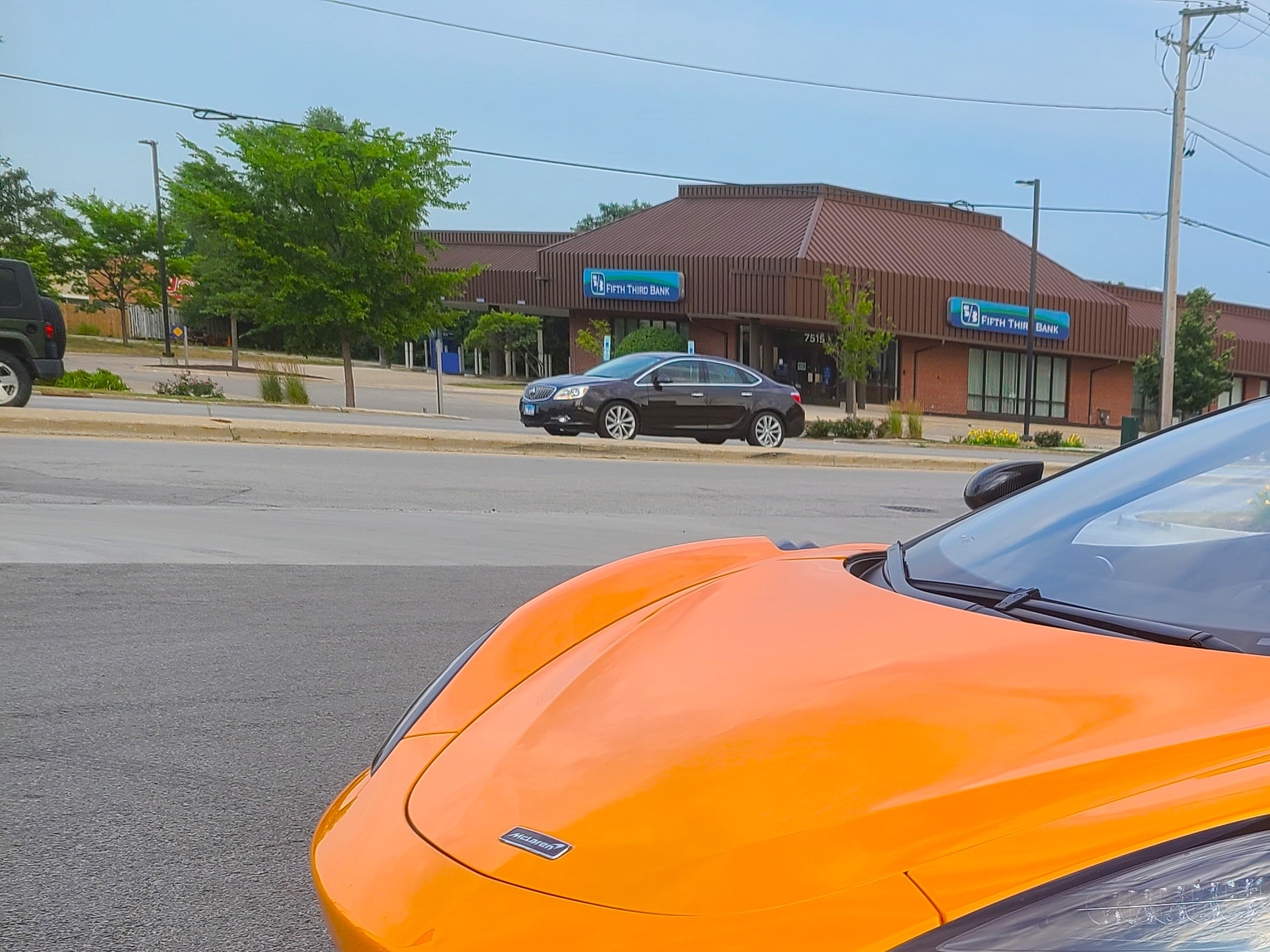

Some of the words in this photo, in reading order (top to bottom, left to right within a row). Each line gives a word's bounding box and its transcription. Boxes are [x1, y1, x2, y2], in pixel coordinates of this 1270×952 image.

[606, 283, 626, 294] FIFTH
[627, 284, 648, 295] THIRD
[650, 284, 670, 296] BANK
[981, 315, 1006, 328] FIFTH
[1008, 318, 1029, 331] THIR
[1036, 322, 1059, 334] BANK
[508, 832, 554, 850] McLaren
